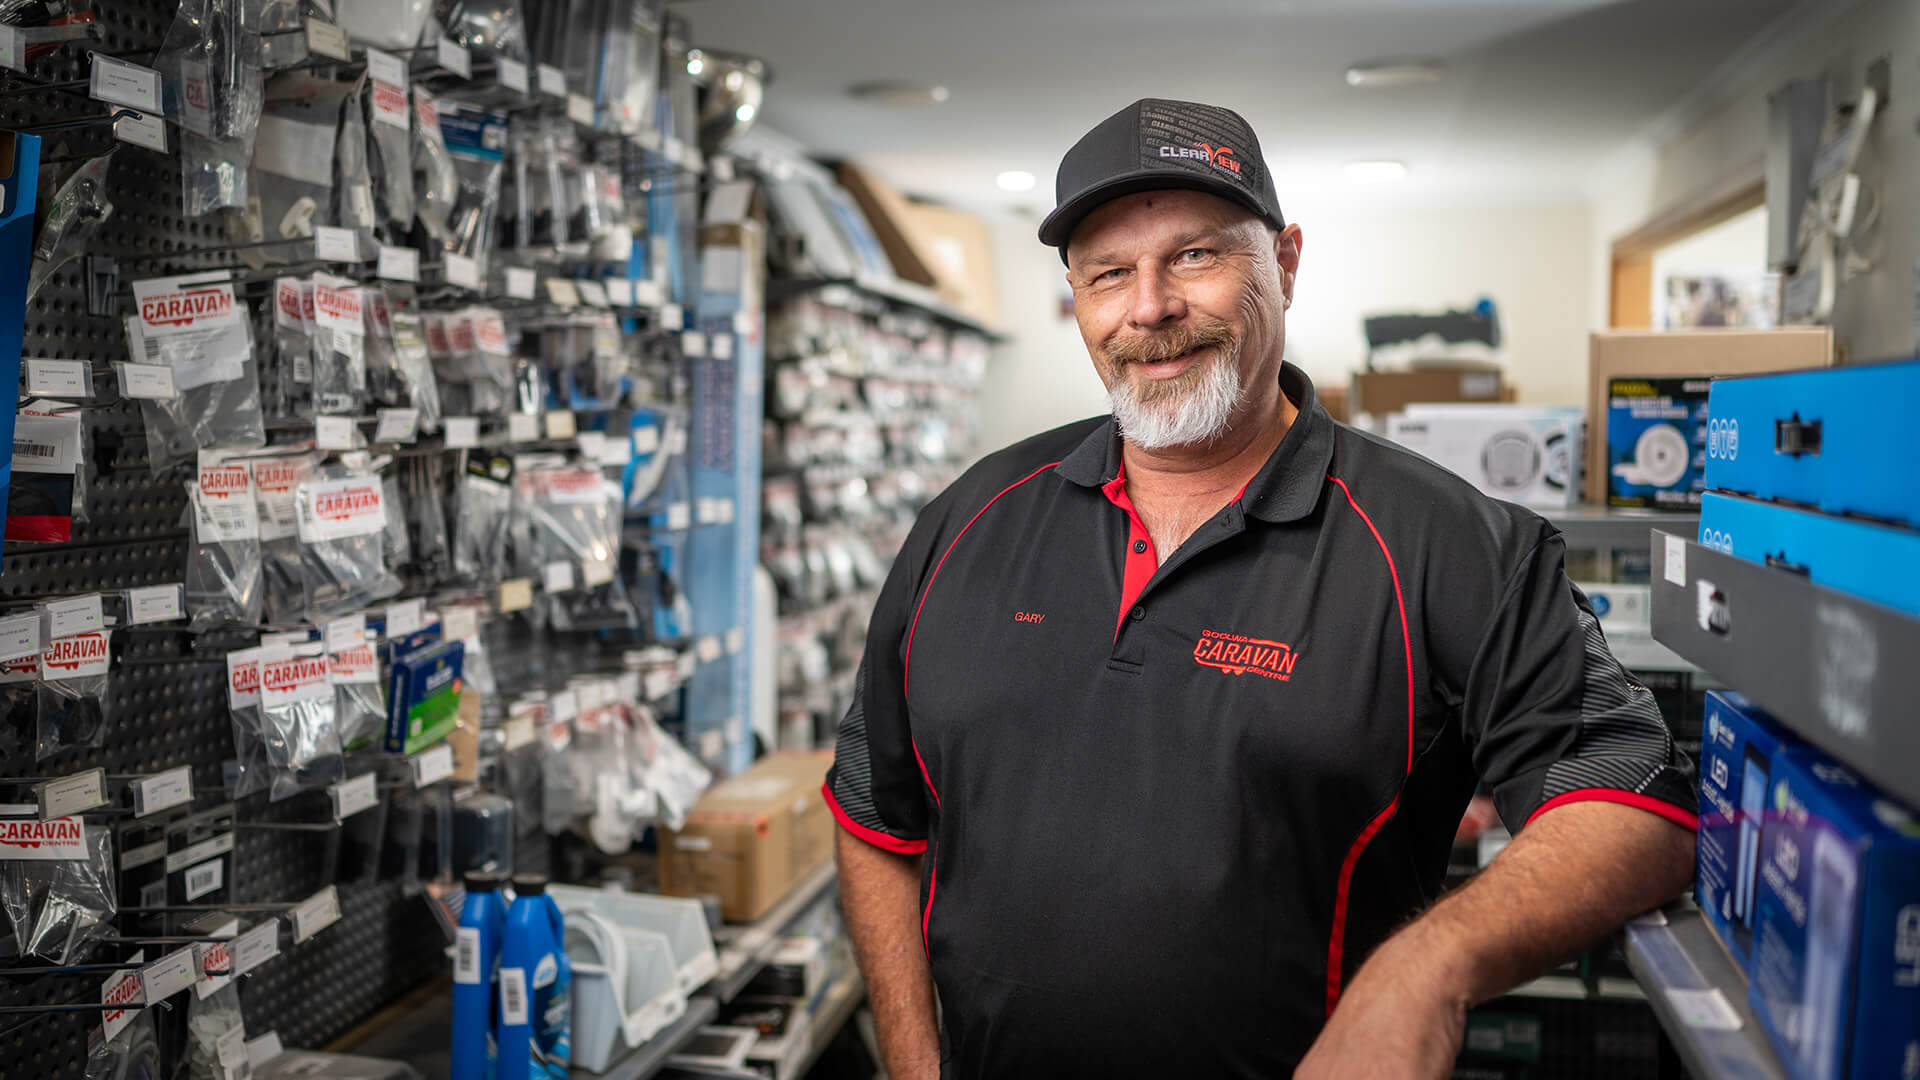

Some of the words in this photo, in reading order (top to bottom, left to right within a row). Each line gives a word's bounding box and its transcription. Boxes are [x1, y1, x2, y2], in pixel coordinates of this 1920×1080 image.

[143, 292, 231, 320] CARAVAN
[201, 472, 249, 491] CARAVAN
[316, 494, 379, 515] CARAVAN
[1014, 611, 1046, 624] GARY
[1193, 638, 1299, 674] CARAVAN
[263, 660, 326, 686] CARAVAN
[1246, 666, 1290, 682] CENTRE
[1710, 754, 1728, 790] LED
